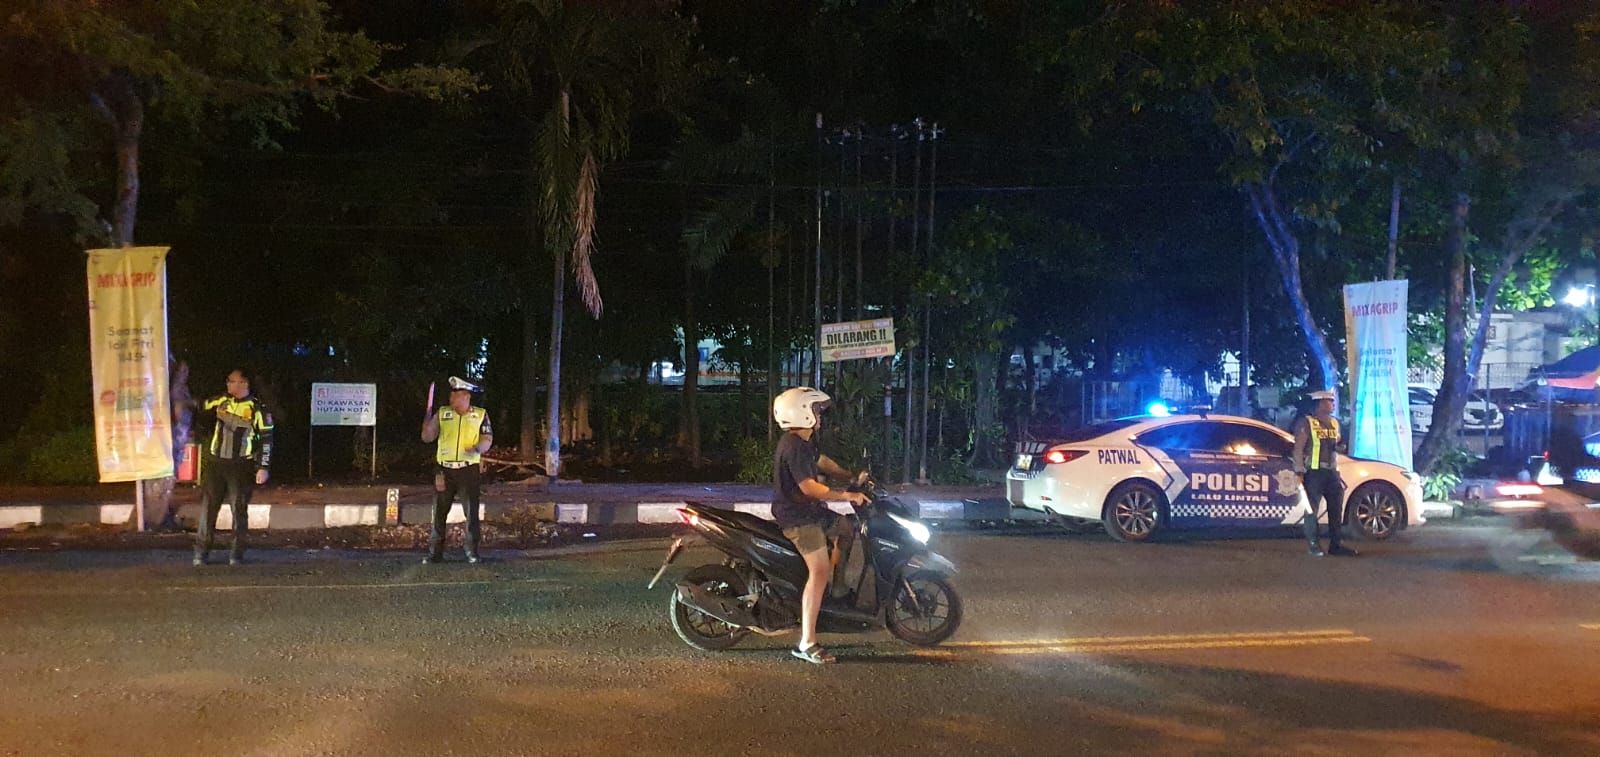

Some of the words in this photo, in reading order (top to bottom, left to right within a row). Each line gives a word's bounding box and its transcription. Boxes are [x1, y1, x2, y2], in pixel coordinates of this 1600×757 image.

[1353, 303, 1398, 317] MIXAGRIP
[826, 330, 877, 345] DILARANG
[262, 444, 270, 466] POLISI
[1098, 449, 1142, 465] PATWAL
[1191, 472, 1269, 492] POLISI
[1191, 493, 1222, 501] LALU
[1224, 494, 1269, 502] LINTAS
